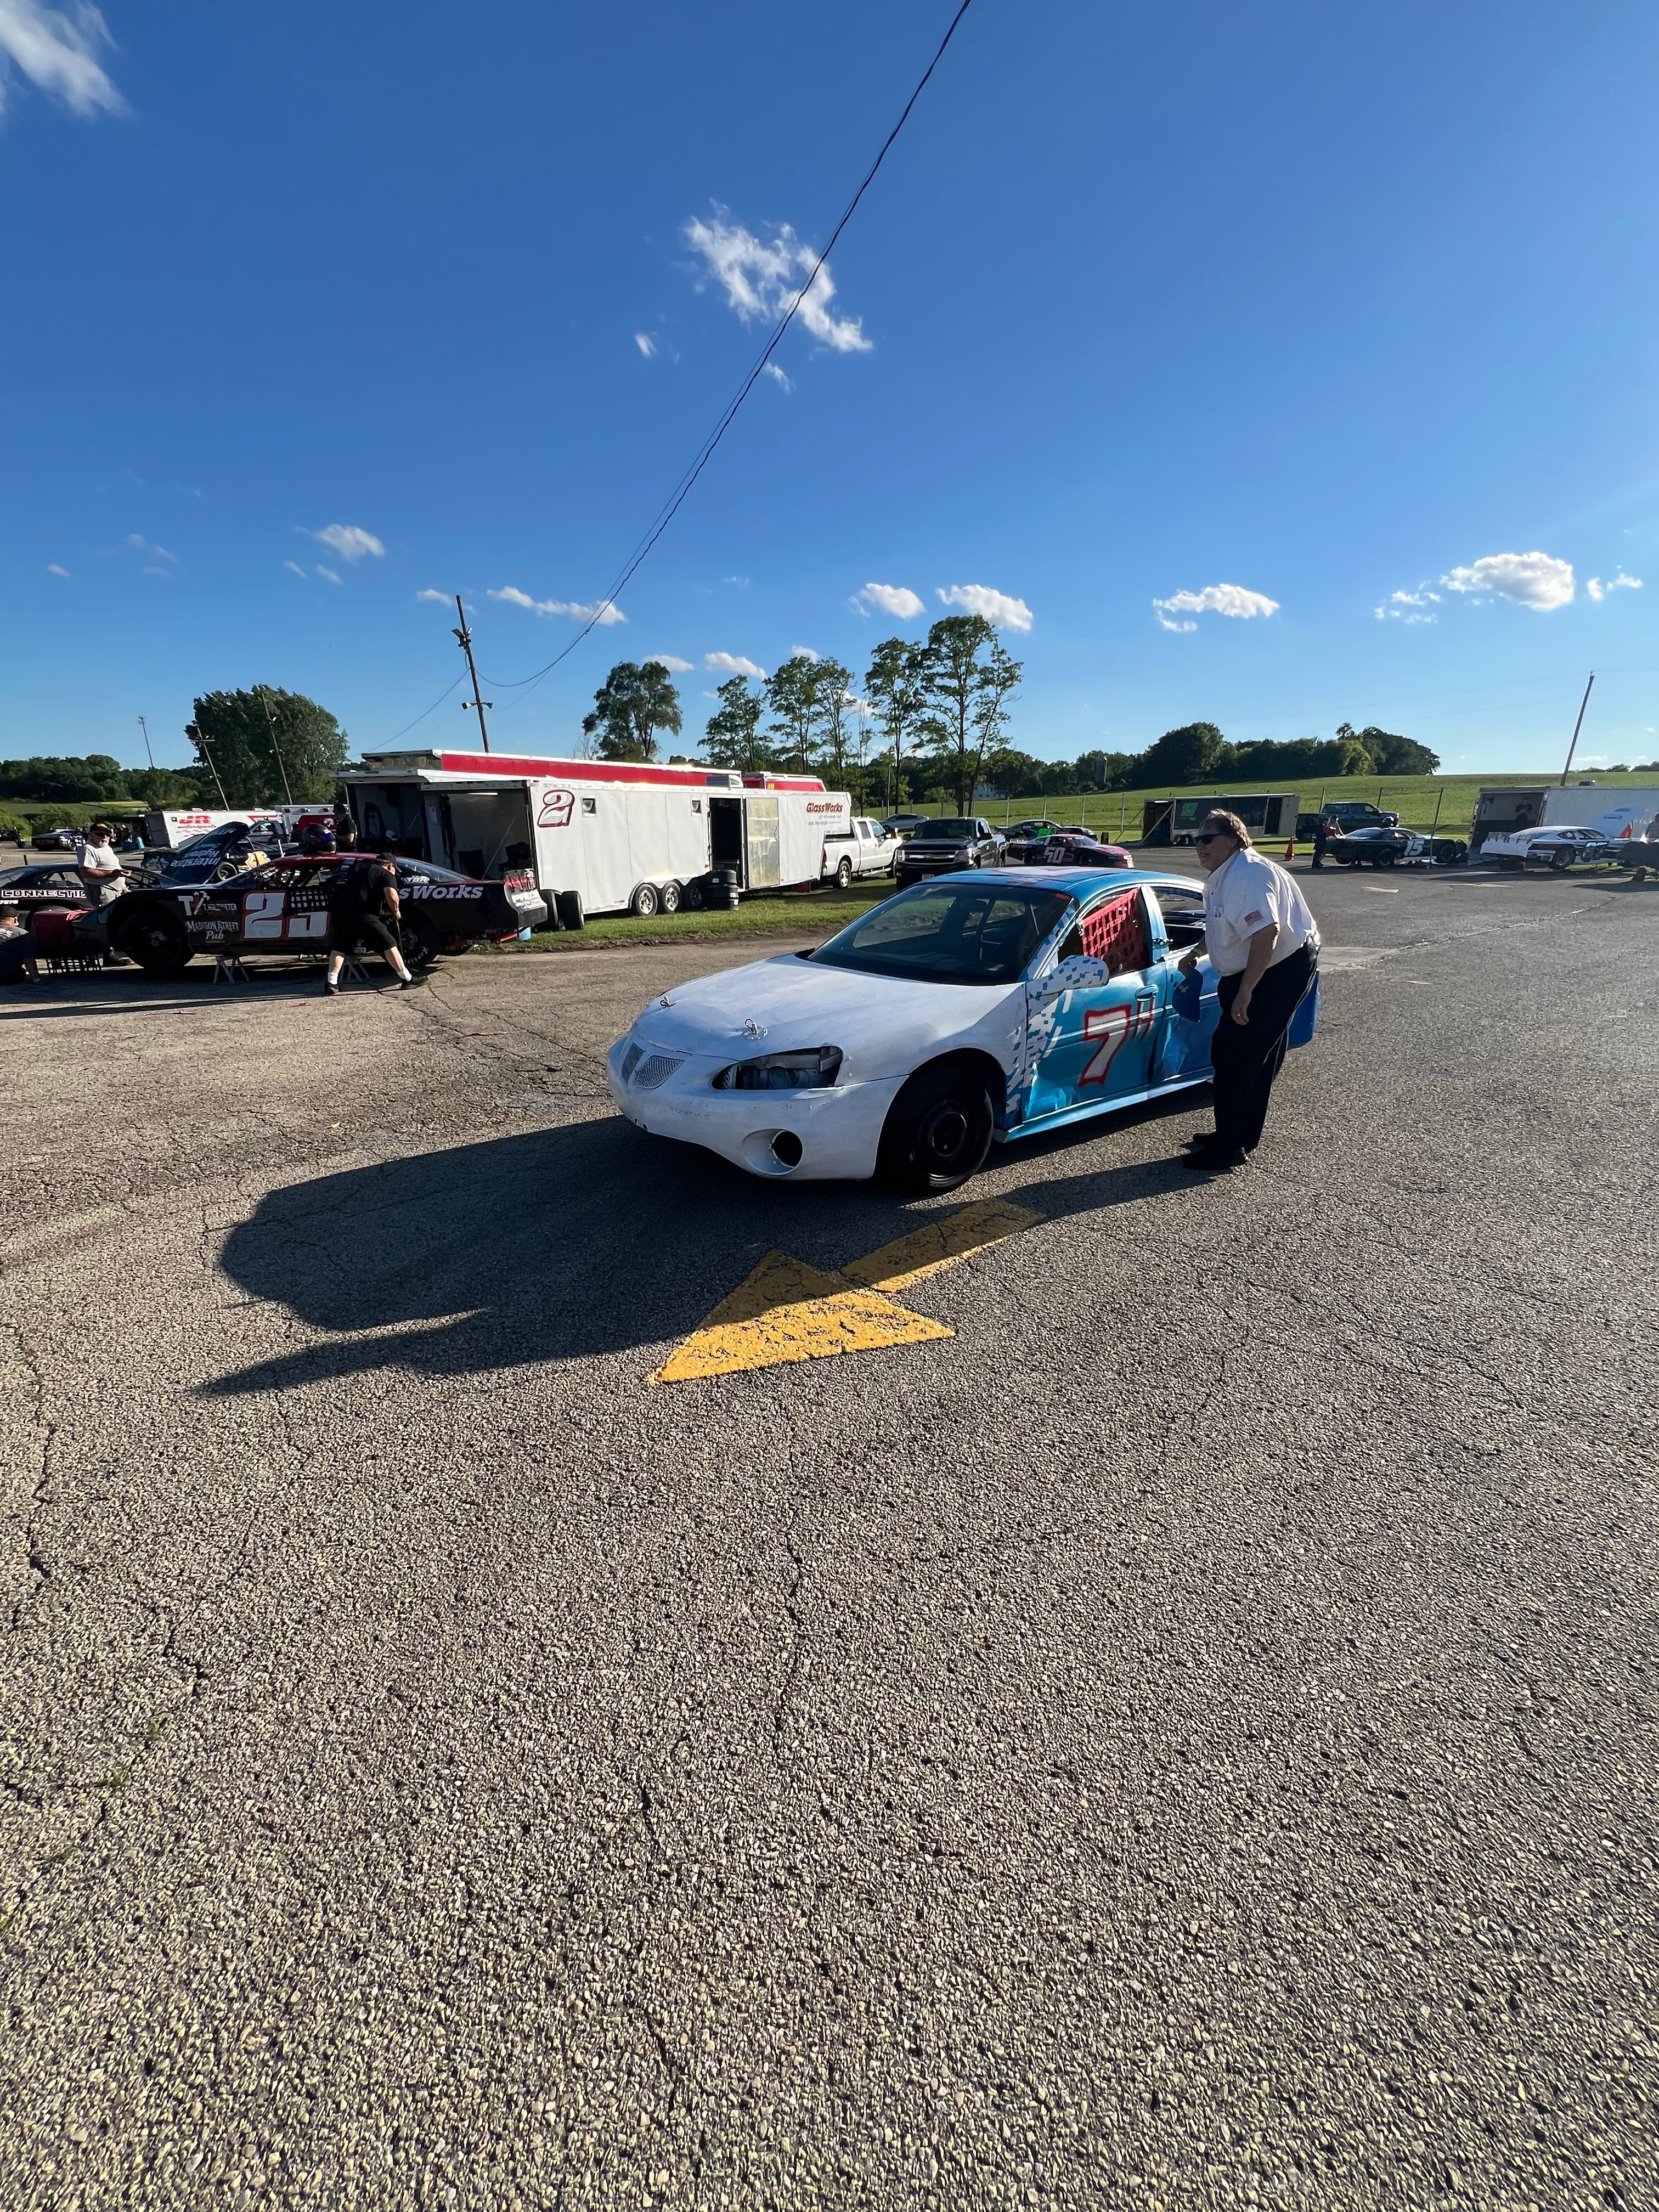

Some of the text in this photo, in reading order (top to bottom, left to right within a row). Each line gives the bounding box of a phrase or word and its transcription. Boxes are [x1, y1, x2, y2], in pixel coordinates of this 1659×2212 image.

[537, 789, 575, 828] 2
[806, 803, 843, 813] GlassWorks
[1044, 847, 1066, 864] 50
[1404, 840, 1425, 856] 15
[399, 885, 484, 900] sWorks
[185, 921, 240, 932] MADISON STREET
[206, 930, 224, 940] Pub
